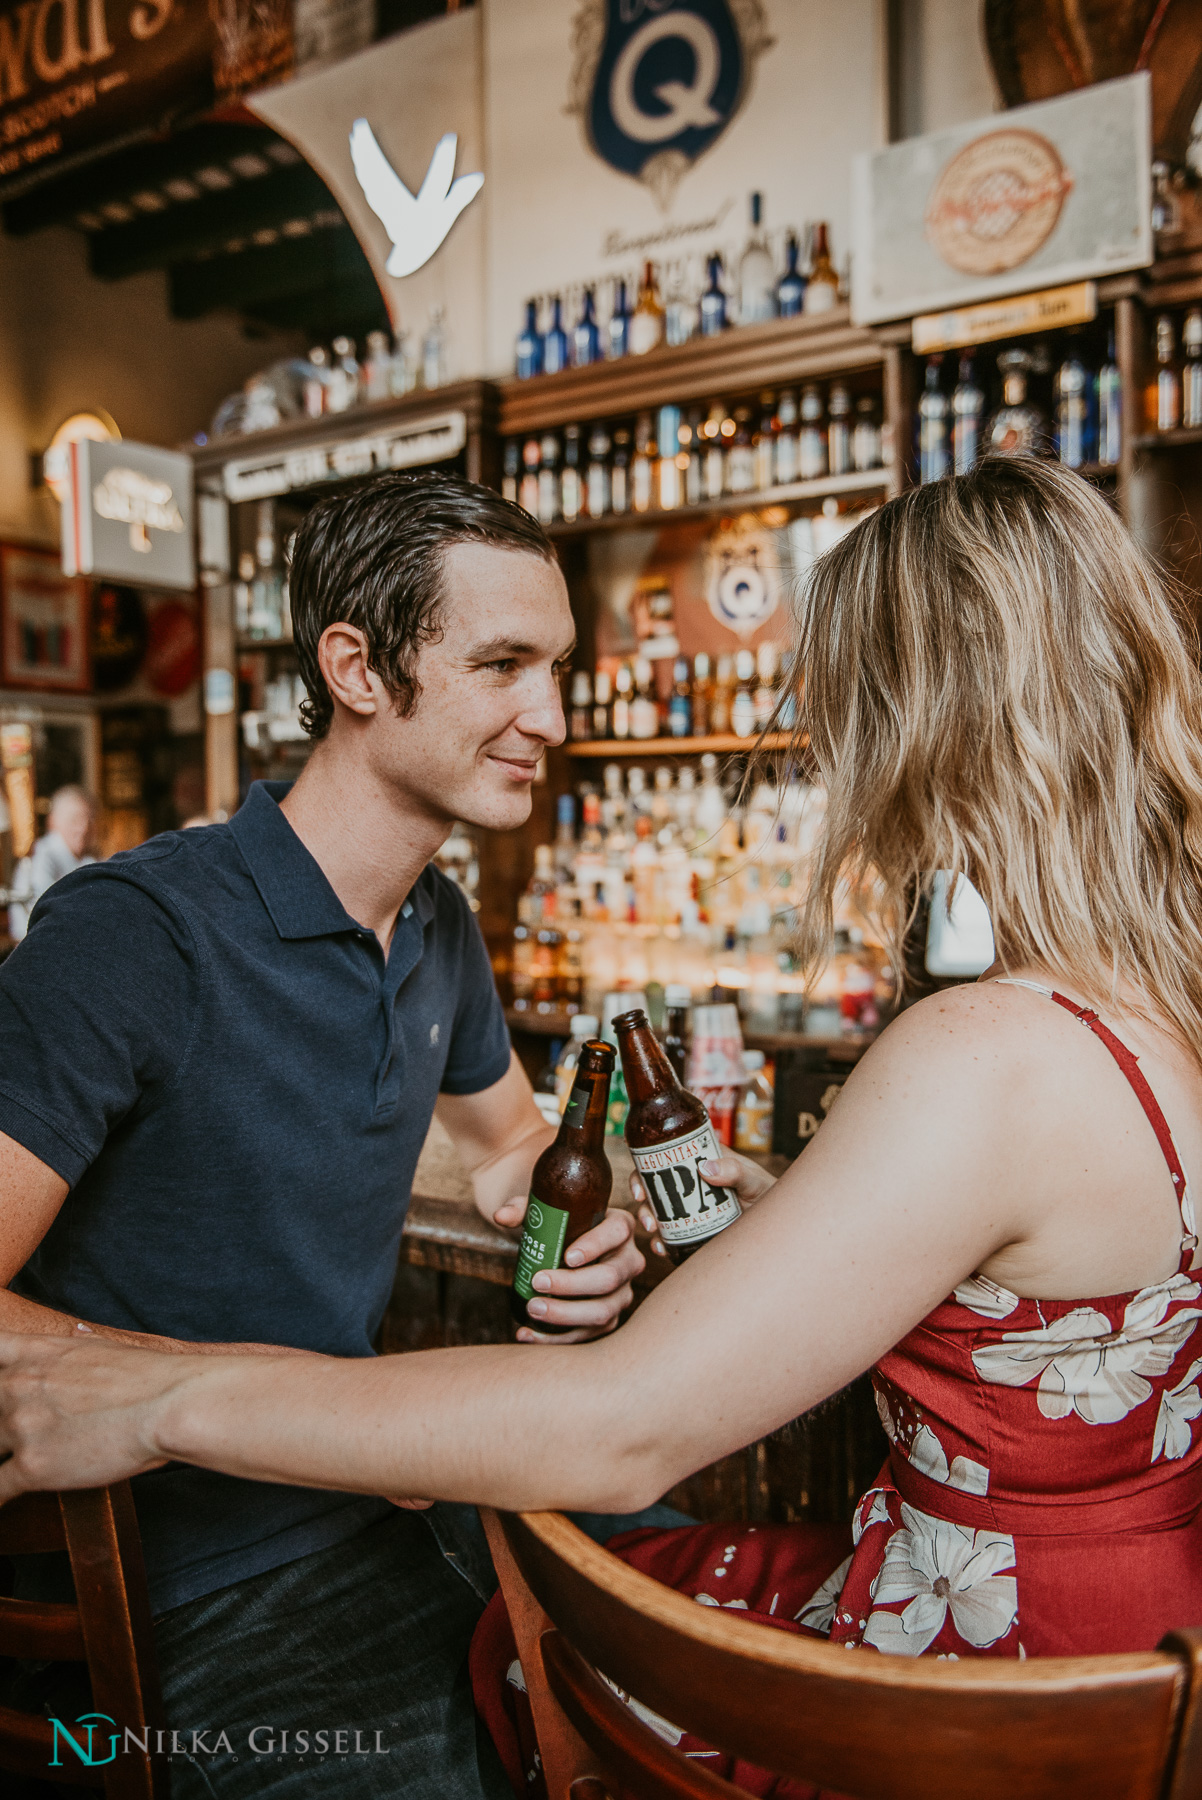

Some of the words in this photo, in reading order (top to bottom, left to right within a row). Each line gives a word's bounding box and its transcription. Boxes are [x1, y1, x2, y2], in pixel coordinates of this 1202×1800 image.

[609, 9, 723, 145] Q
[637, 1140, 699, 1170] LAGUNITAS
[641, 1156, 729, 1222] IPA
[684, 1213, 711, 1226] PALE
[716, 1202, 732, 1214] ALE
[523, 1231, 546, 1252] OOSE
